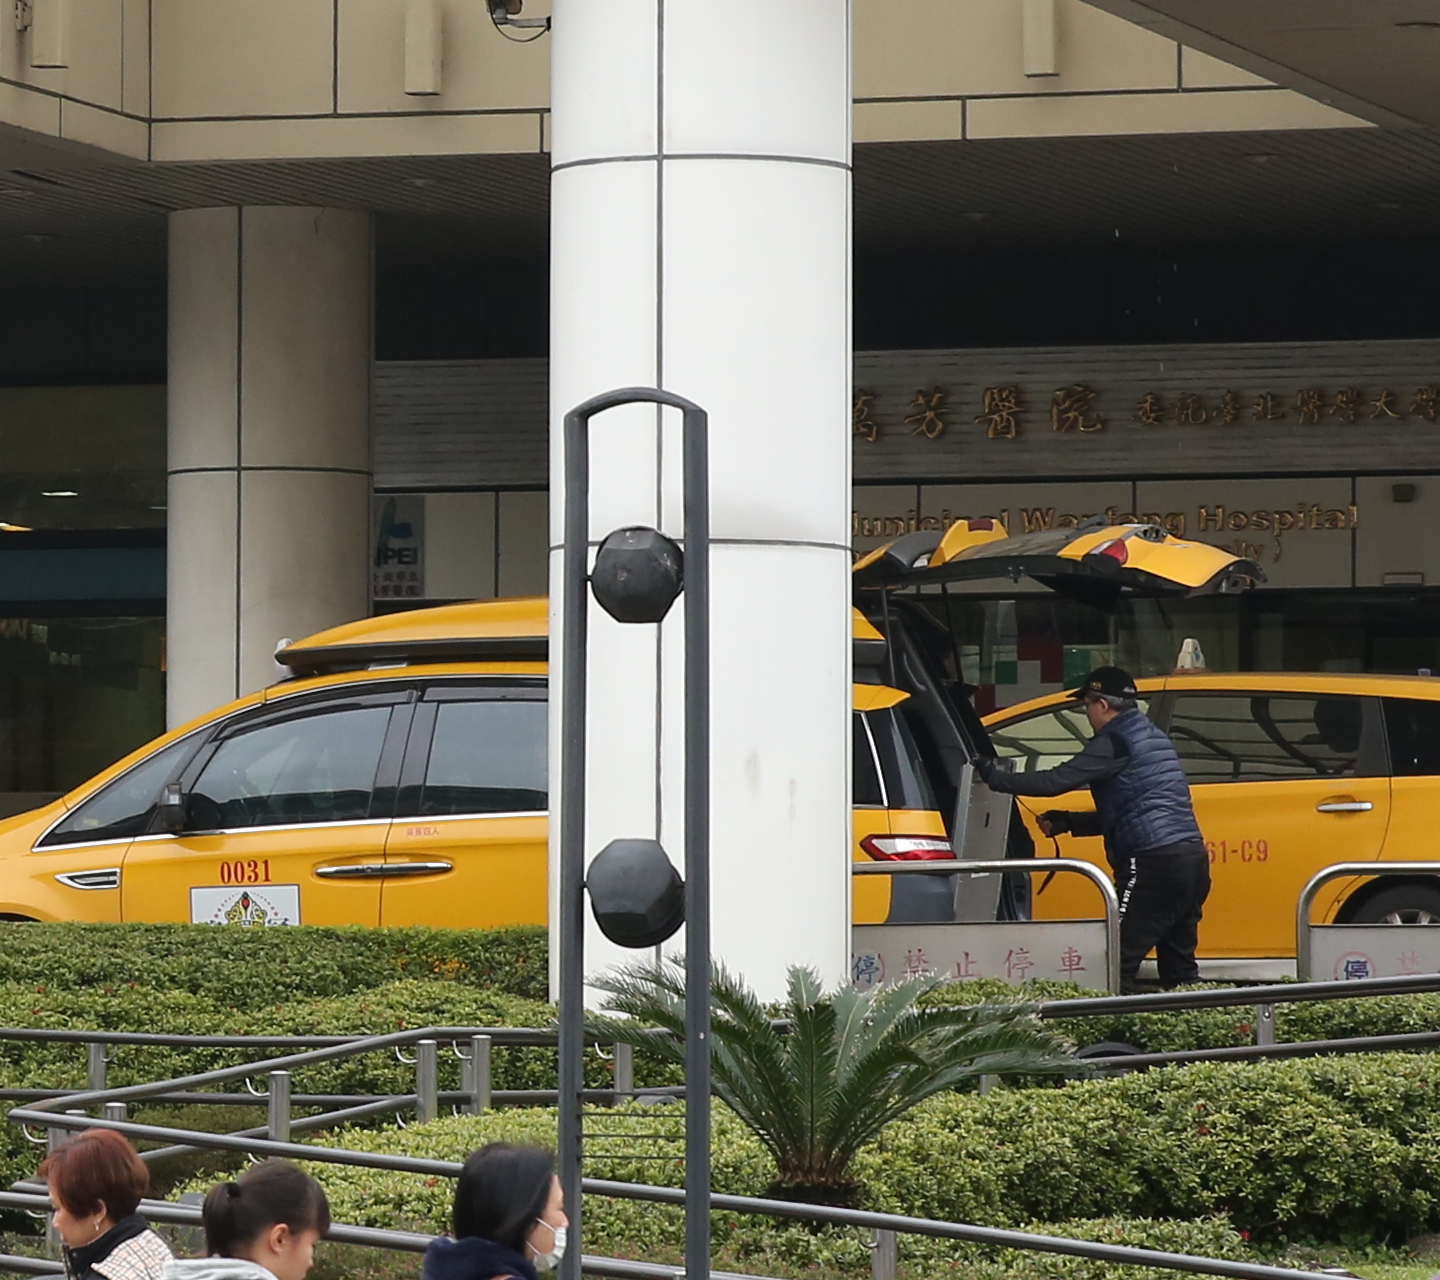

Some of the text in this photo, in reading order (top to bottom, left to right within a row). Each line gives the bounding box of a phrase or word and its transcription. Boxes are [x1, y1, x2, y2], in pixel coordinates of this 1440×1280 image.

[1198, 502, 1359, 537] Hospital
[1206, 839, 1269, 864] 61-C9
[220, 858, 272, 884] 0031
